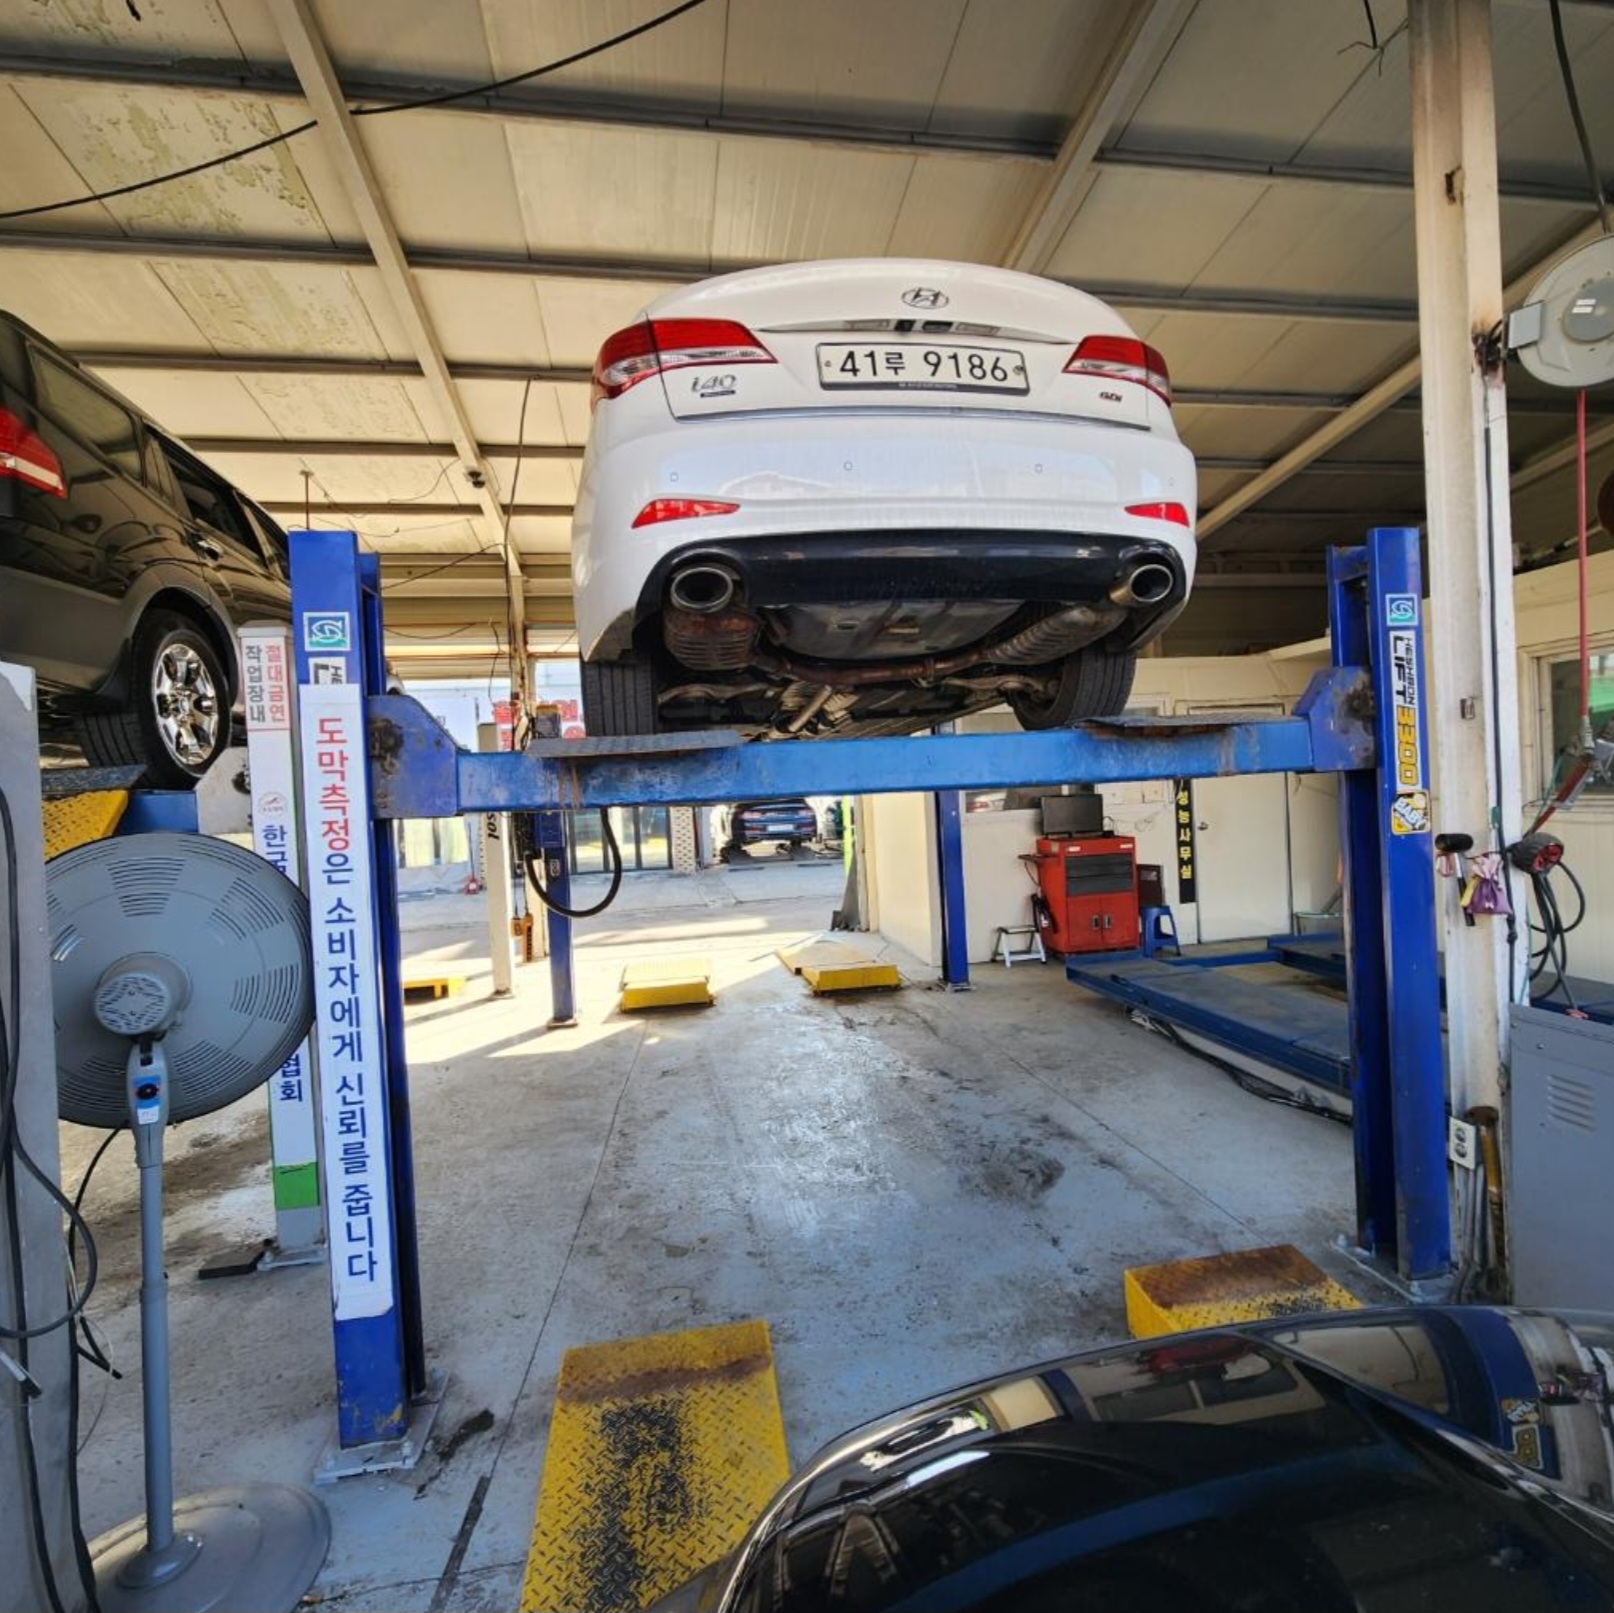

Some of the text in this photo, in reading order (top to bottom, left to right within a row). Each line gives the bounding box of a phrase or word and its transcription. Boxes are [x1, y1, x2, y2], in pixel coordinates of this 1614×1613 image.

[691, 374, 736, 392] i40
[840, 350, 1008, 382] 41루 9186
[246, 645, 266, 723] 작업장내
[265, 645, 285, 723] 절대금연
[1393, 635, 1407, 704] LIFT
[1405, 637, 1415, 705] HESHBON
[1396, 704, 1418, 786] 3300
[315, 717, 378, 1283] 도막측정은 소비자에게 신뢰를 줍니다
